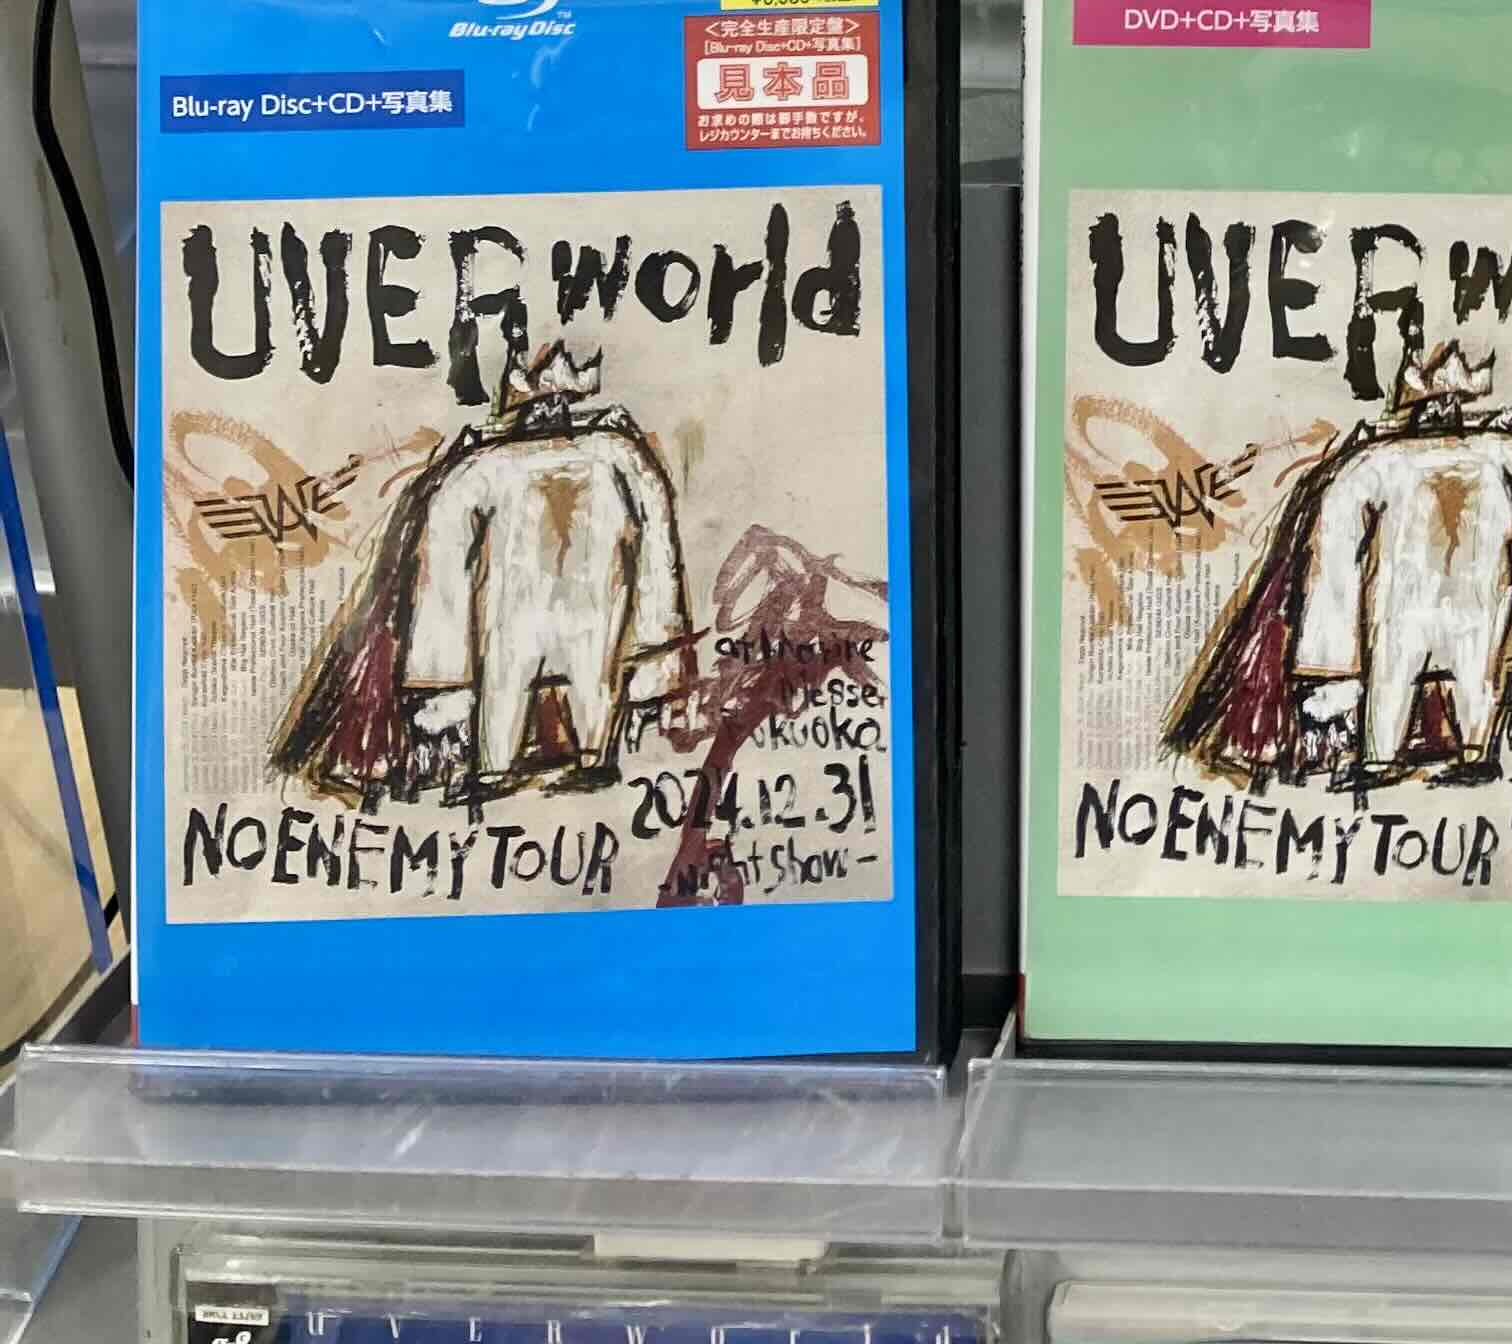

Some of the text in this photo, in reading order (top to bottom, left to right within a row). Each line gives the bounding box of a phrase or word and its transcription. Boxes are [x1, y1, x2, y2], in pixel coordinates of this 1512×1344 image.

[529, 17, 576, 38] Disc
[1124, 6, 1320, 35] DVD+CD+写真集
[714, 61, 850, 103] 見本品
[172, 88, 453, 124] Blu-ray Disc+CD+写真集
[182, 200, 862, 406] UVERworld
